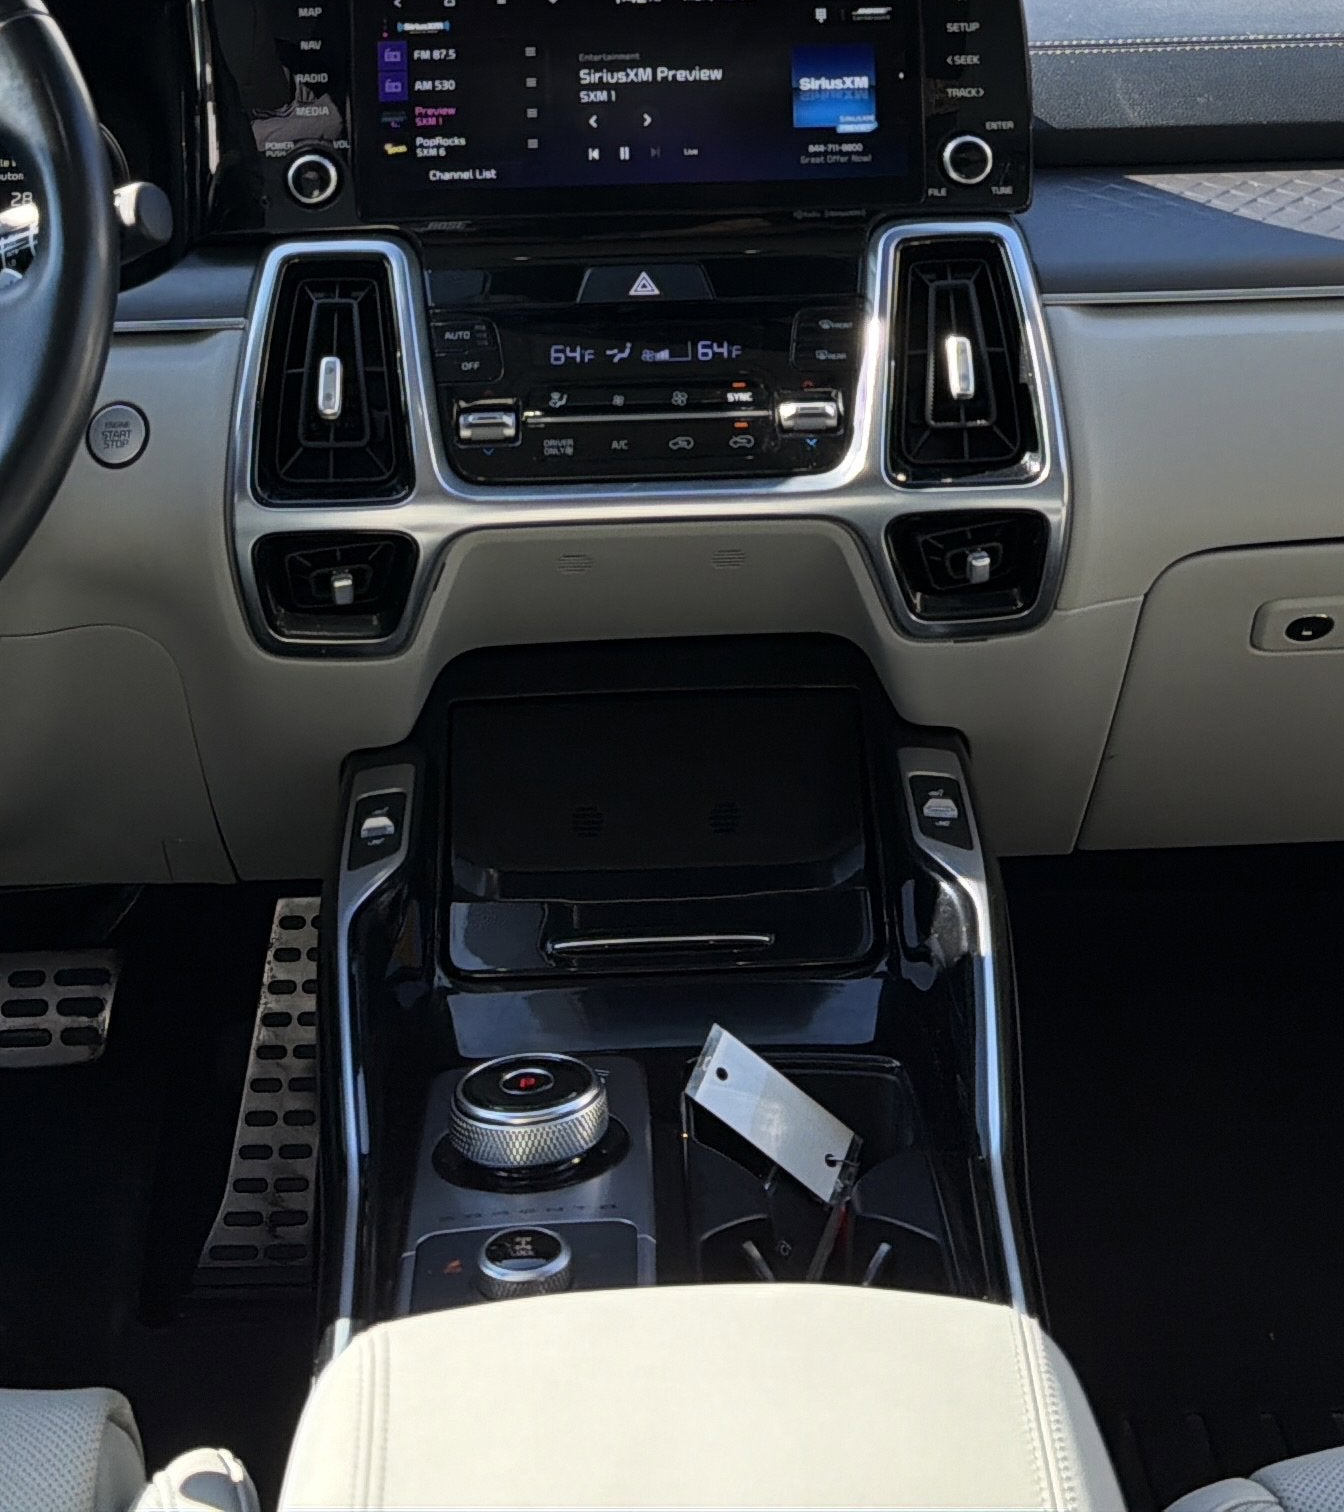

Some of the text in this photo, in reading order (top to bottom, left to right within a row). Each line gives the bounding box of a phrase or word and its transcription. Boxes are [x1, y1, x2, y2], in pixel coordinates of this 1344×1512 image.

[298, 7, 323, 18] MAP
[946, 22, 980, 33] SETUP
[300, 40, 322, 51] NAV
[413, 48, 457, 61] FM 87.5
[578, 52, 641, 63] Entertainment
[954, 55, 980, 65] SEEK
[296, 73, 329, 84] RADIO
[579, 65, 724, 85] SiriusXM Preview
[414, 79, 456, 92] AM 530
[798, 76, 870, 91] SiriusXM
[579, 89, 616, 103] SXM 1
[946, 88, 978, 98] TRACK
[296, 106, 329, 117] MEDIA
[415, 106, 456, 116] Preview
[415, 117, 436, 127] SXM
[985, 120, 1015, 130] ENTER
[333, 140, 351, 149] VOL
[416, 135, 467, 148] PopRocks
[416, 148, 438, 158] SXM
[429, 168, 497, 182] Channel List
[928, 187, 947, 197] FILE
[991, 185, 1014, 195] TUNE
[444, 330, 471, 340] AUTO
[460, 361, 481, 372] OFF
[726, 391, 754, 403] SYNC
[101, 429, 132, 440] START
[103, 439, 129, 450] STOP
[543, 439, 575, 448] DRIVER
[611, 440, 629, 450] A/C
[519, 1077, 536, 1089] P
